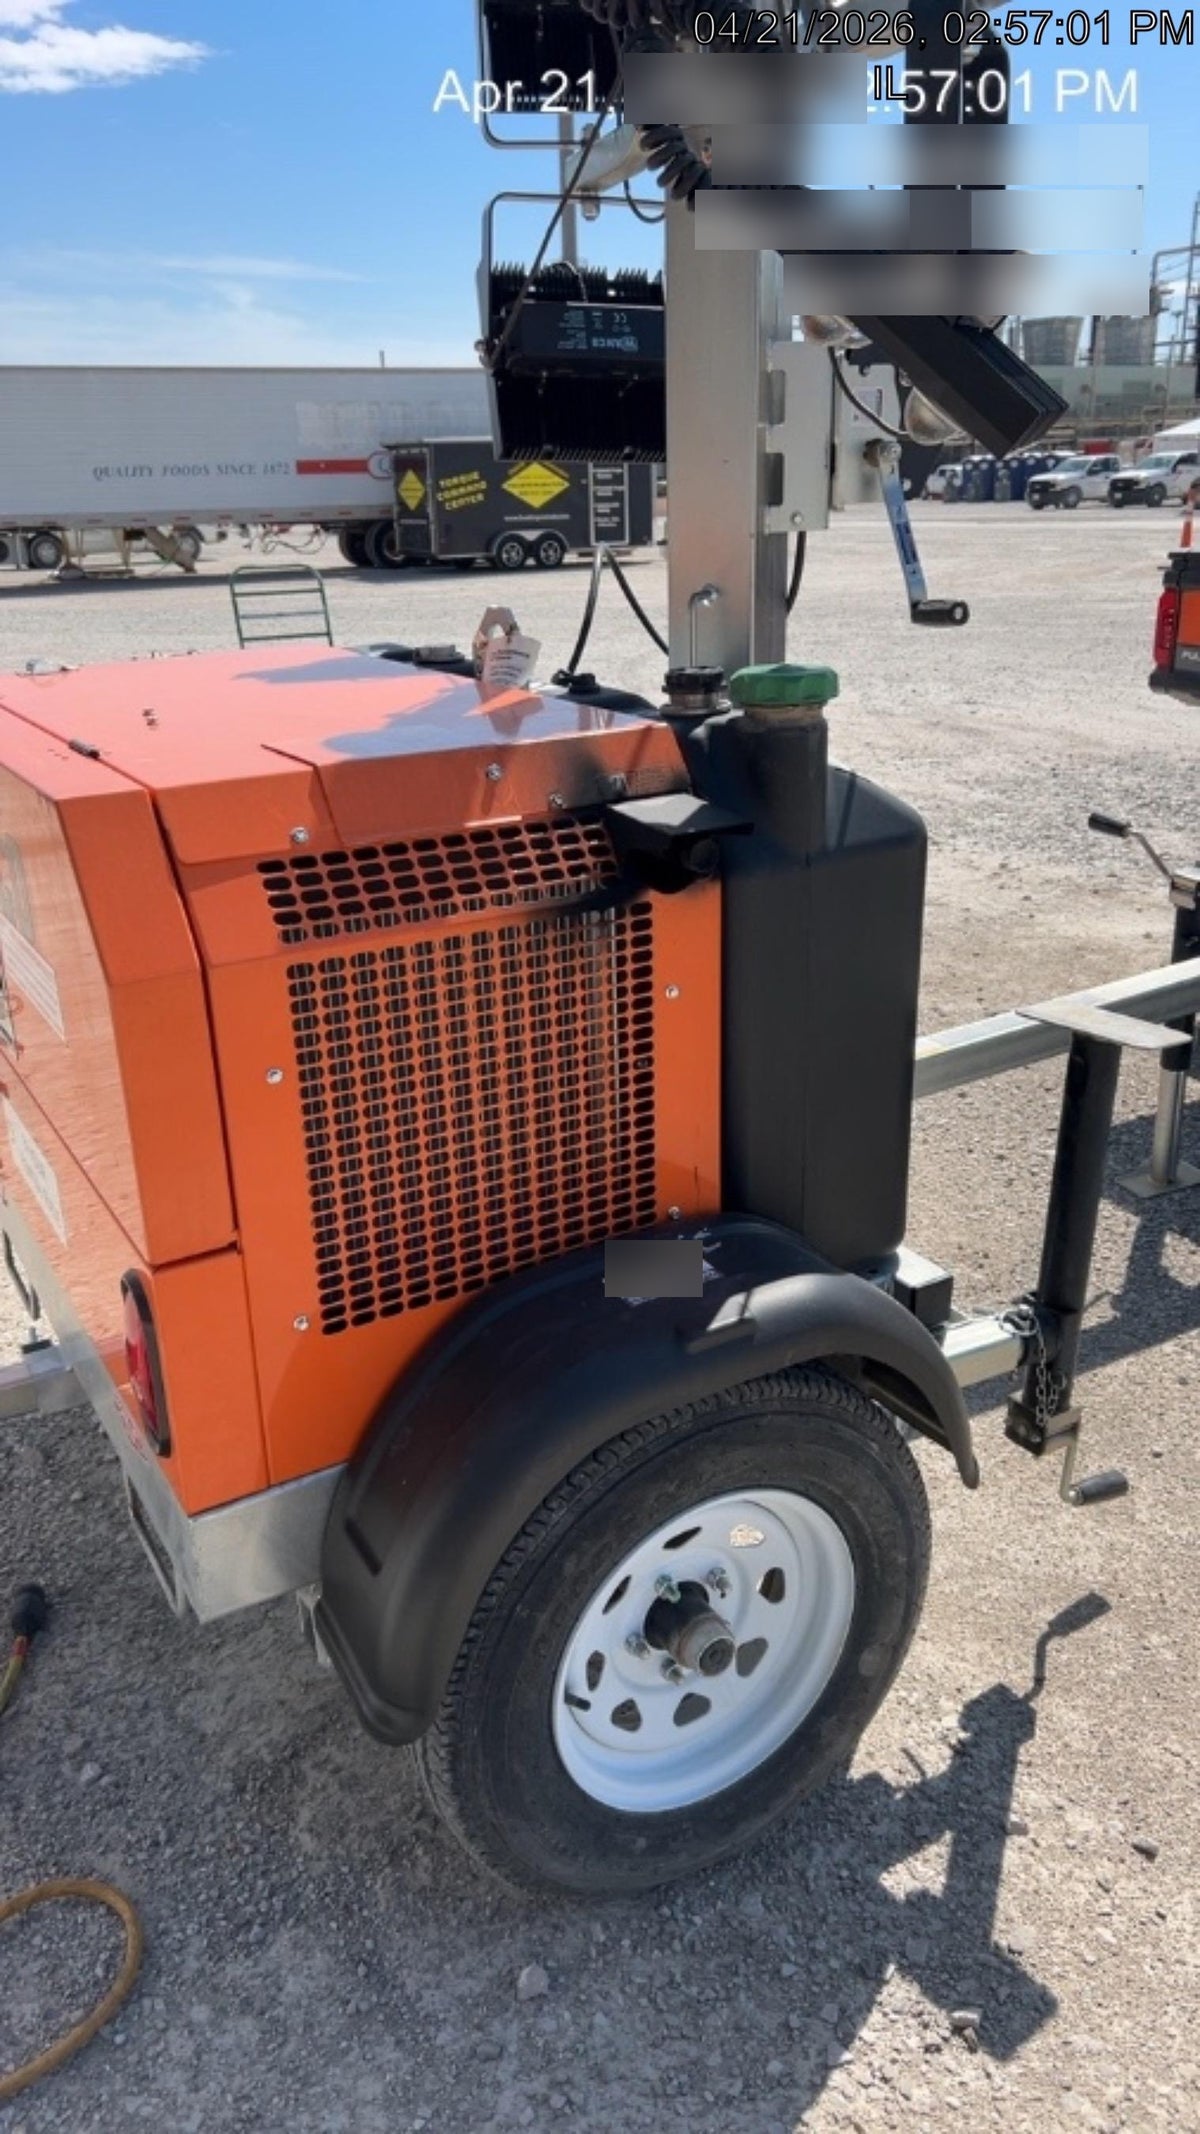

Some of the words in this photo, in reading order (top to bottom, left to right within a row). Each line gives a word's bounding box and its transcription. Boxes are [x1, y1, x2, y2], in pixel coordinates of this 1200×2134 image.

[93, 465, 153, 482] QUALITY
[162, 463, 210, 478] FOODS
[217, 461, 257, 477] SINCE
[439, 470, 480, 489] TORQUE
[436, 480, 487, 502] COMMAND
[445, 492, 485, 511] CENTER
